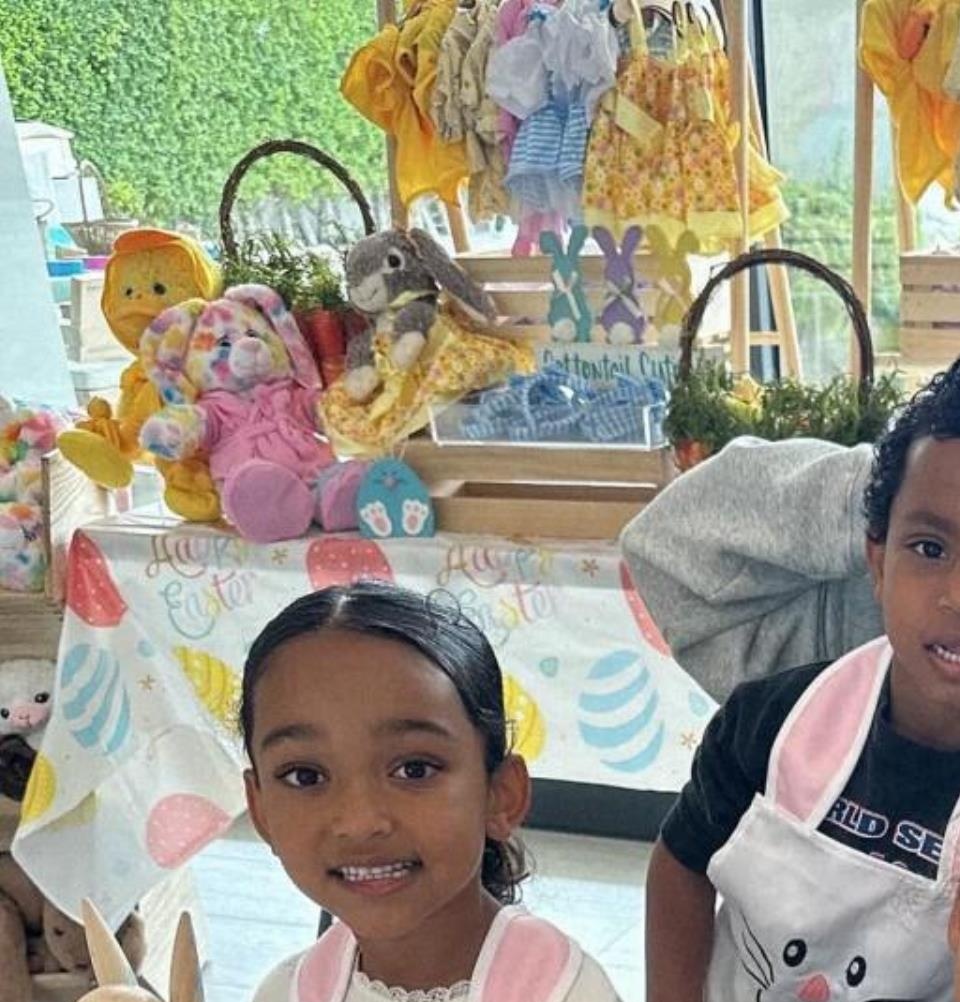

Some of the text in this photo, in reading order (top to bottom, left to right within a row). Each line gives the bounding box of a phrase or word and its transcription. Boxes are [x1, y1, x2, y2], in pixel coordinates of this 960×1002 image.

[158, 570, 257, 640] Easter
[828, 797, 944, 864] RLD SE
